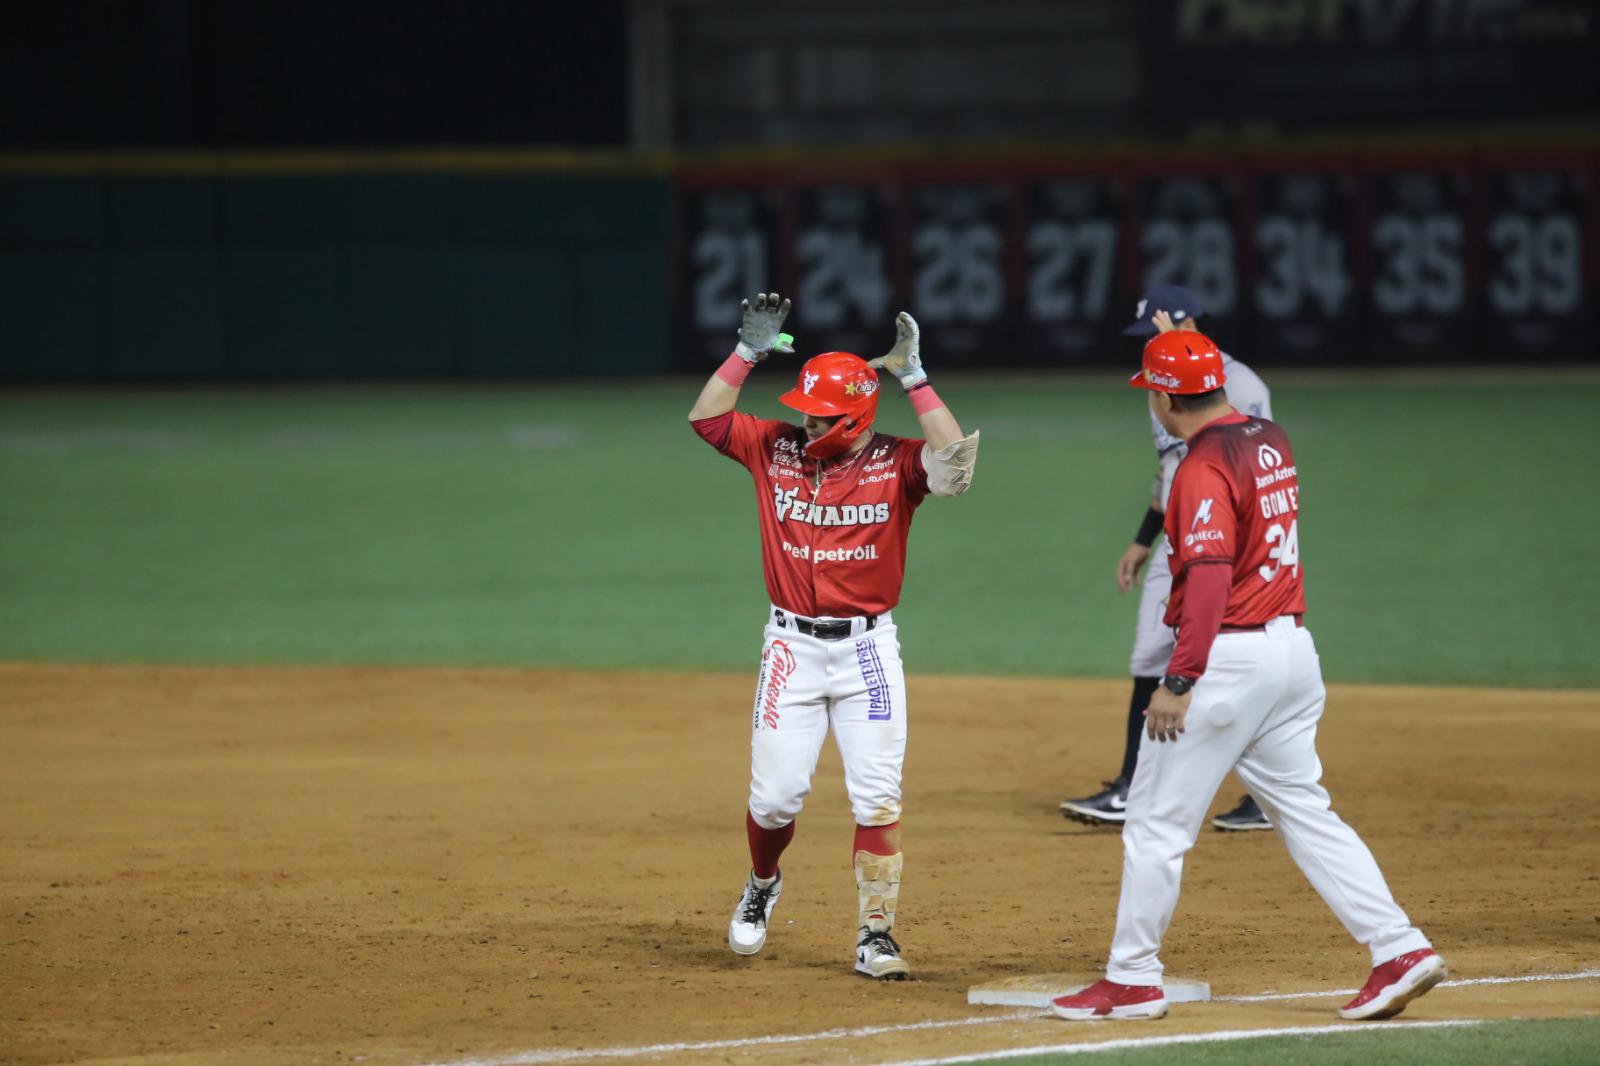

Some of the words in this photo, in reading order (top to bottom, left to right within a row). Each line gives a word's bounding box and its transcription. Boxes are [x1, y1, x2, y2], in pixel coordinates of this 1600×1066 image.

[694, 232, 766, 327] 21
[797, 227, 889, 326] 24
[914, 224, 1004, 321] 26
[1027, 221, 1119, 319] 27
[1142, 218, 1235, 315] 28
[1256, 216, 1350, 316] 34
[1374, 214, 1464, 313] 35
[1489, 212, 1581, 314] 39
[774, 482, 891, 526] VENADOS
[1258, 518, 1299, 583] 34
[1260, 486, 1300, 519] GOME
[783, 541, 810, 560] red
[813, 544, 876, 563] petroil
